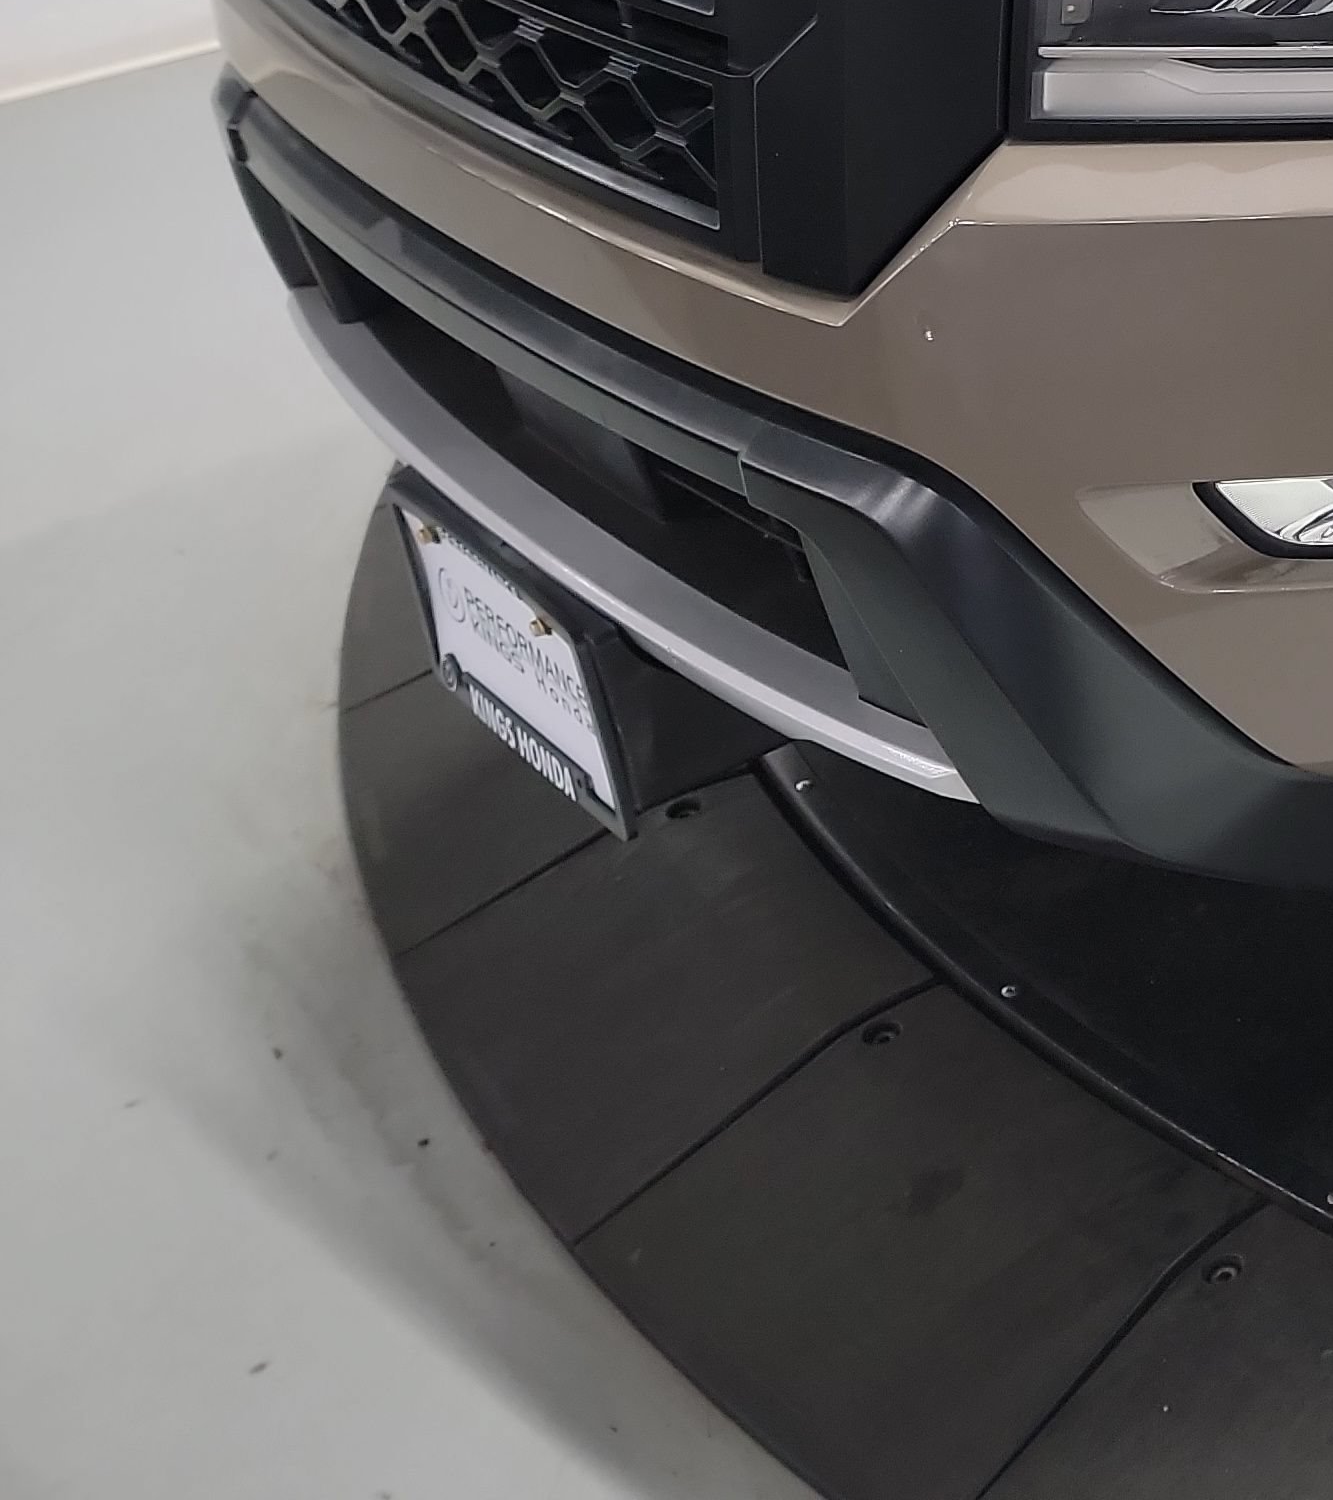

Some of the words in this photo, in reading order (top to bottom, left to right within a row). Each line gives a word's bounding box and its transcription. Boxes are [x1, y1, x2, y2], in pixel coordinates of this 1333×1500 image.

[463, 586, 588, 710] PERFORMANCE
[468, 682, 517, 750] KINGS
[516, 726, 578, 804] HONDA
